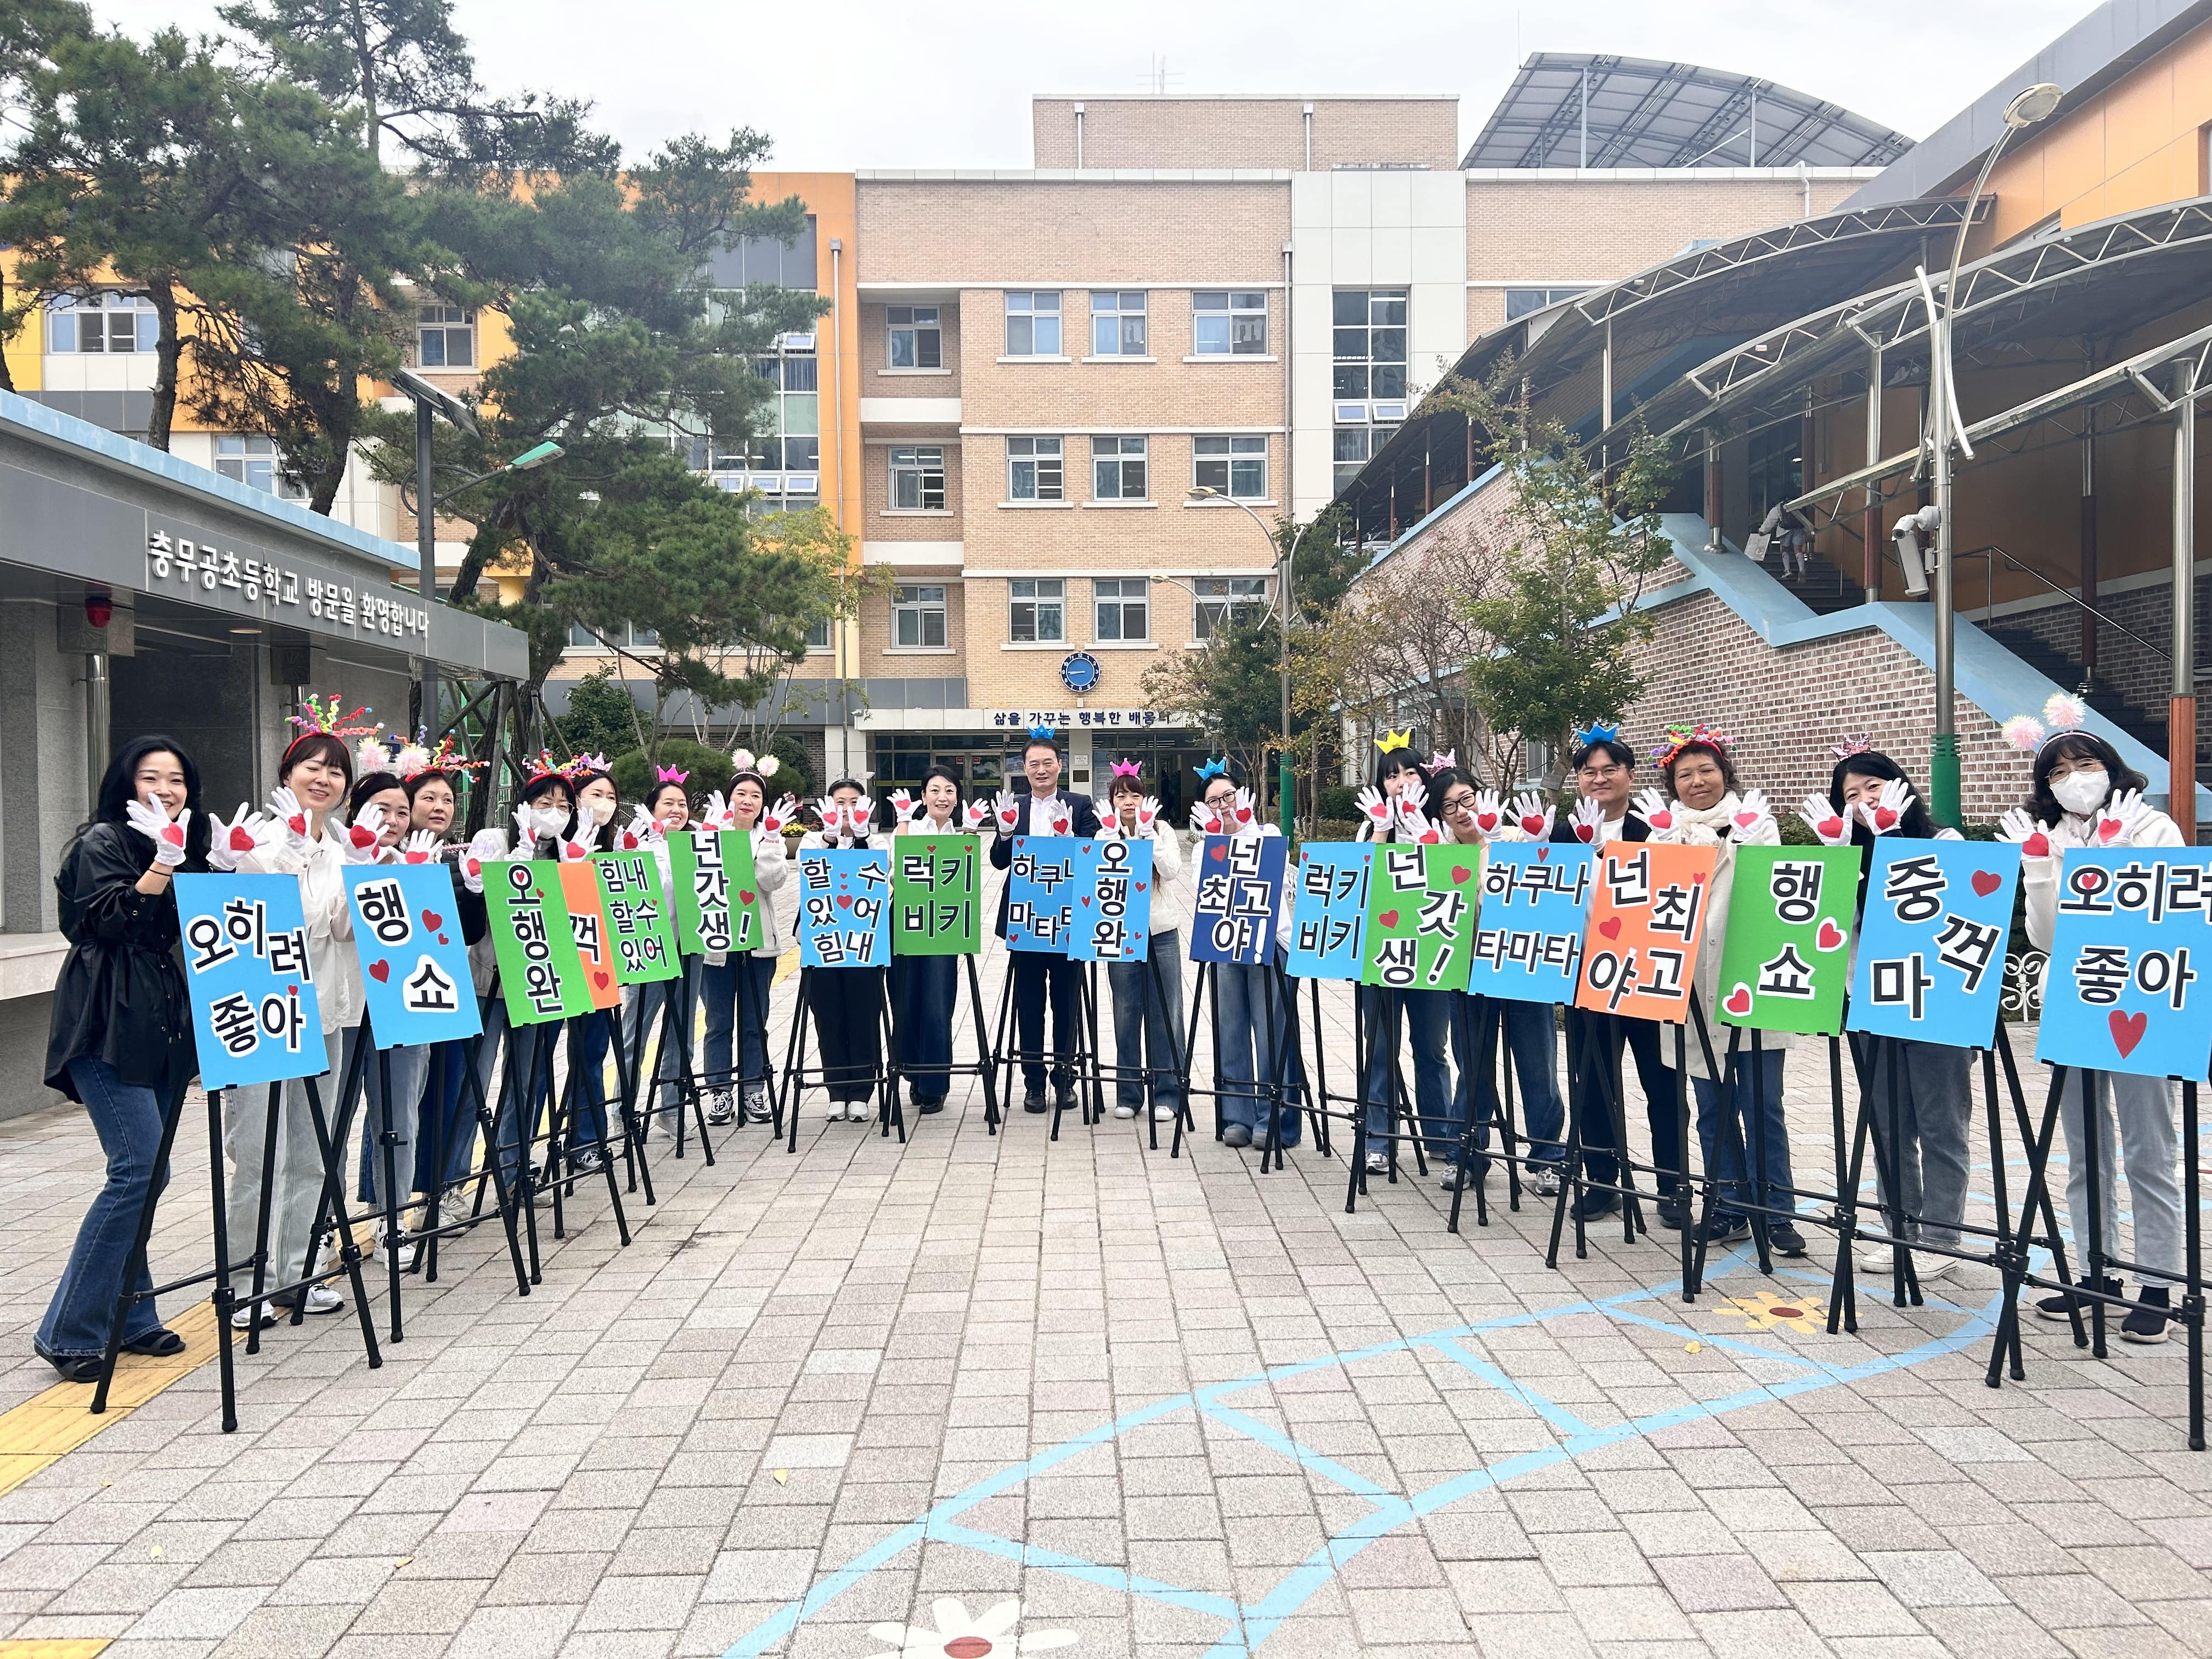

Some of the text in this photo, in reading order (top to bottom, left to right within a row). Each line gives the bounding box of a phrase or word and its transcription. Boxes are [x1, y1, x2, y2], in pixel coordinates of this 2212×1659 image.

[147, 529, 430, 639] 충무공초등학교 방문을 환영합니다
[994, 712, 1022, 726] 삶을
[1029, 712, 1071, 725] 가꾸는
[1078, 712, 1121, 725] 행복한
[599, 858, 649, 893] 힘내
[904, 854, 973, 893] 럭키
[1305, 864, 1370, 910] 럭키
[1486, 863, 1590, 905] 하쿠나
[2059, 864, 2212, 923] 오히려
[806, 894, 882, 929] 있어
[904, 899, 970, 939] 비키
[188, 896, 312, 981] 오히려
[619, 934, 668, 973] 있어
[814, 931, 874, 964] 힘내
[1299, 914, 1361, 960] 비키
[1475, 929, 1580, 976] 타마타
[2075, 947, 2194, 1008] 좋아
[212, 994, 304, 1053] 좋아
